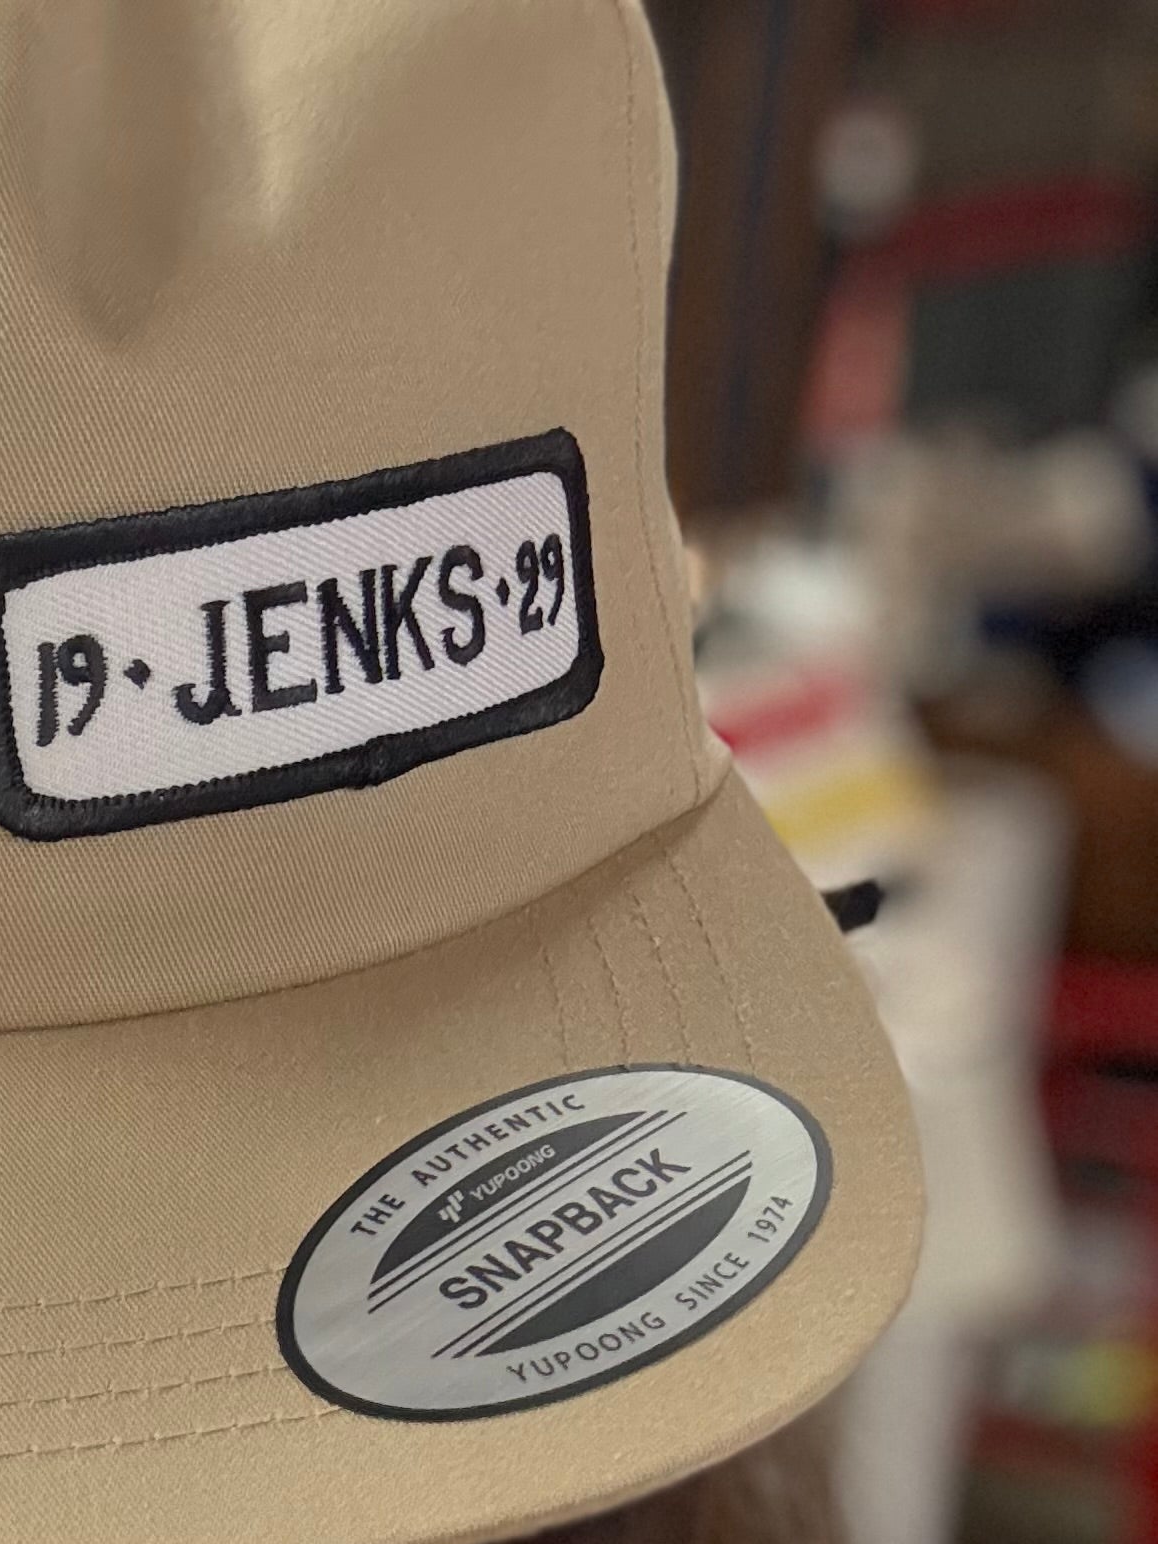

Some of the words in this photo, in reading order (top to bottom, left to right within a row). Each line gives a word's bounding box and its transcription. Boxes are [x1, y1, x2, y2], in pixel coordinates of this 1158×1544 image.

[173, 544, 486, 725] JENKS
[515, 533, 565, 634] 29
[350, 1193, 406, 1238] THE
[410, 1093, 586, 1189] AUTHENTIC
[440, 1147, 692, 1312] SNAPBACK
[469, 1142, 557, 1203] YUPOONG
[507, 1311, 667, 1385] YUPOONG
[675, 1252, 750, 1312] SINCE
[747, 1194, 794, 1246] 1974
